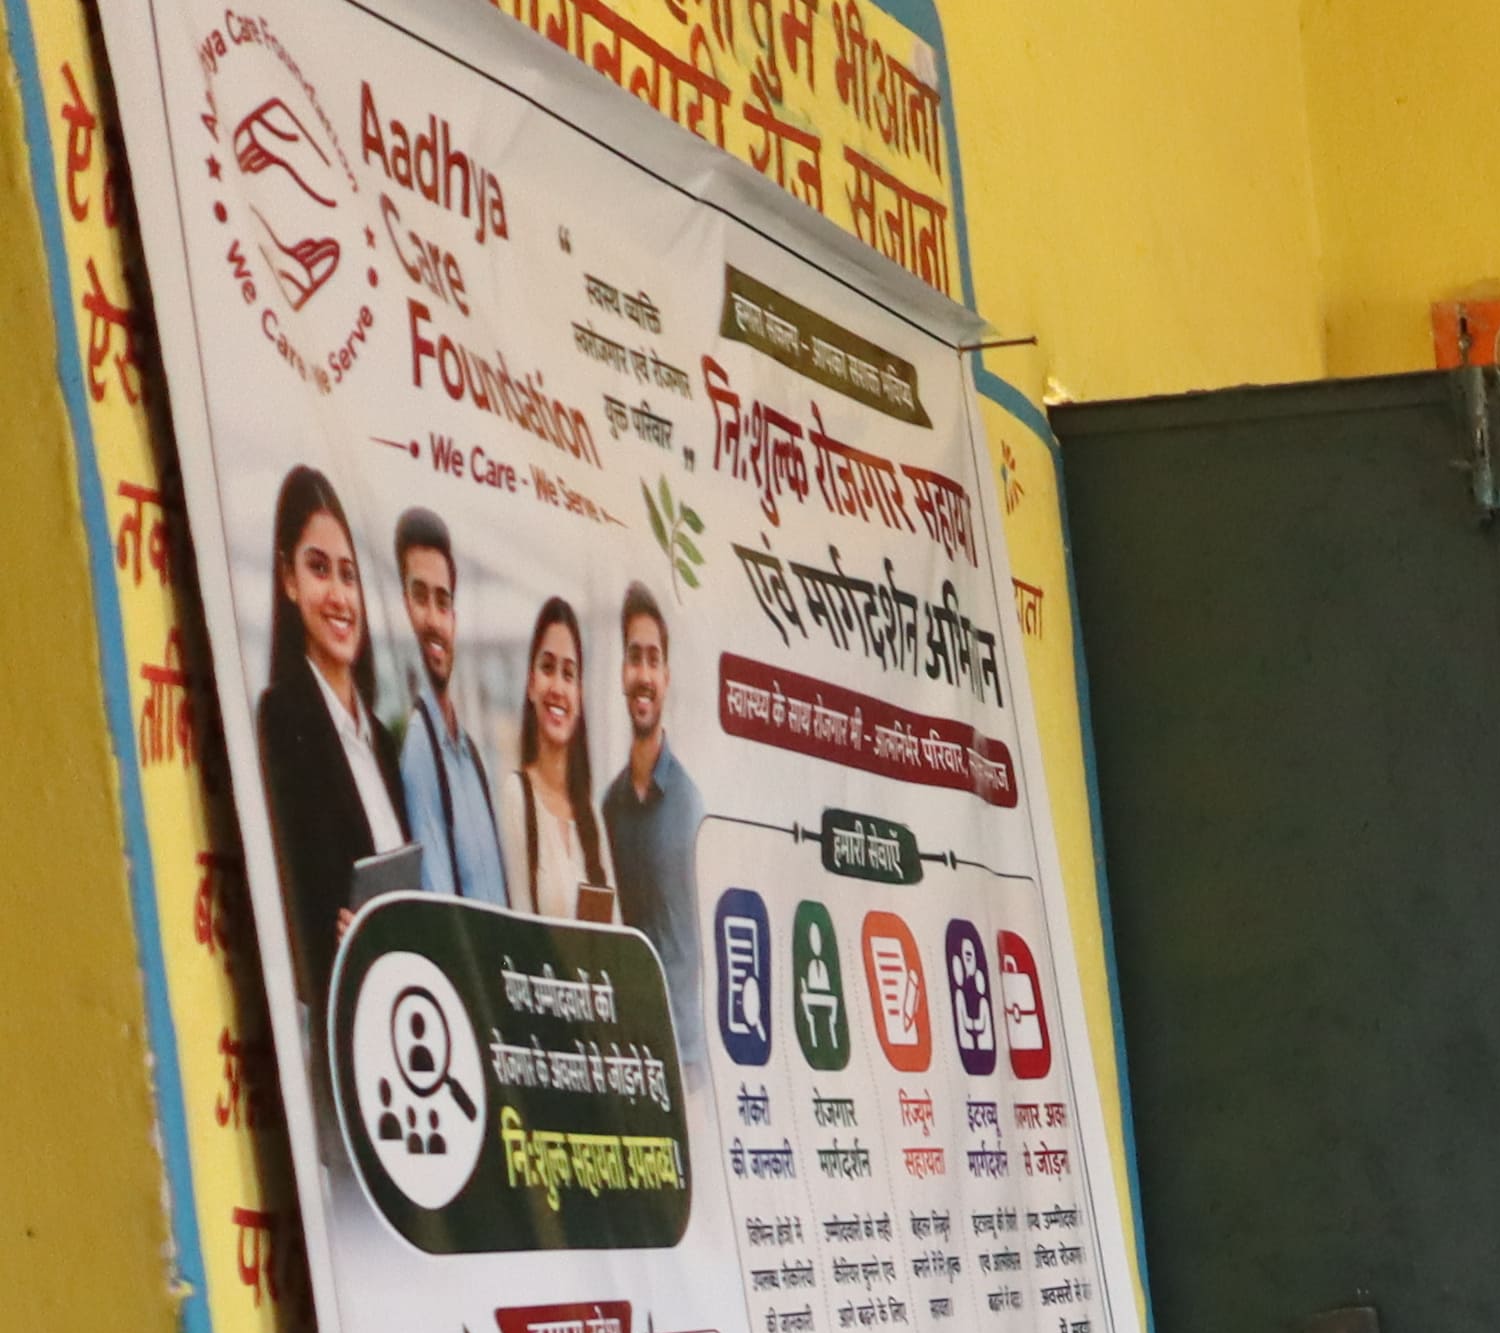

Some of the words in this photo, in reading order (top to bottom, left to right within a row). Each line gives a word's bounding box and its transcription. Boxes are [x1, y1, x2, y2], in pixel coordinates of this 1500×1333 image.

[361, 80, 509, 245] Aadhya
[380, 193, 471, 317] Care
[407, 298, 603, 470] Foundation
[808, 401, 917, 533] रोजगार
[772, 679, 786, 725] के
[788, 698, 812, 737] साथ
[814, 693, 849, 747] रोजगार
[832, 820, 867, 878] हमारी
[737, 1082, 770, 1127] नौकरी
[812, 1086, 857, 1128] रोजगार
[570, 1130, 628, 1197] सहायता
[730, 1137, 747, 1180] की
[749, 1138, 797, 1180] जानकारी
[817, 1139, 872, 1180] मार्गदर्शन
[903, 1146, 946, 1180] सहायता
